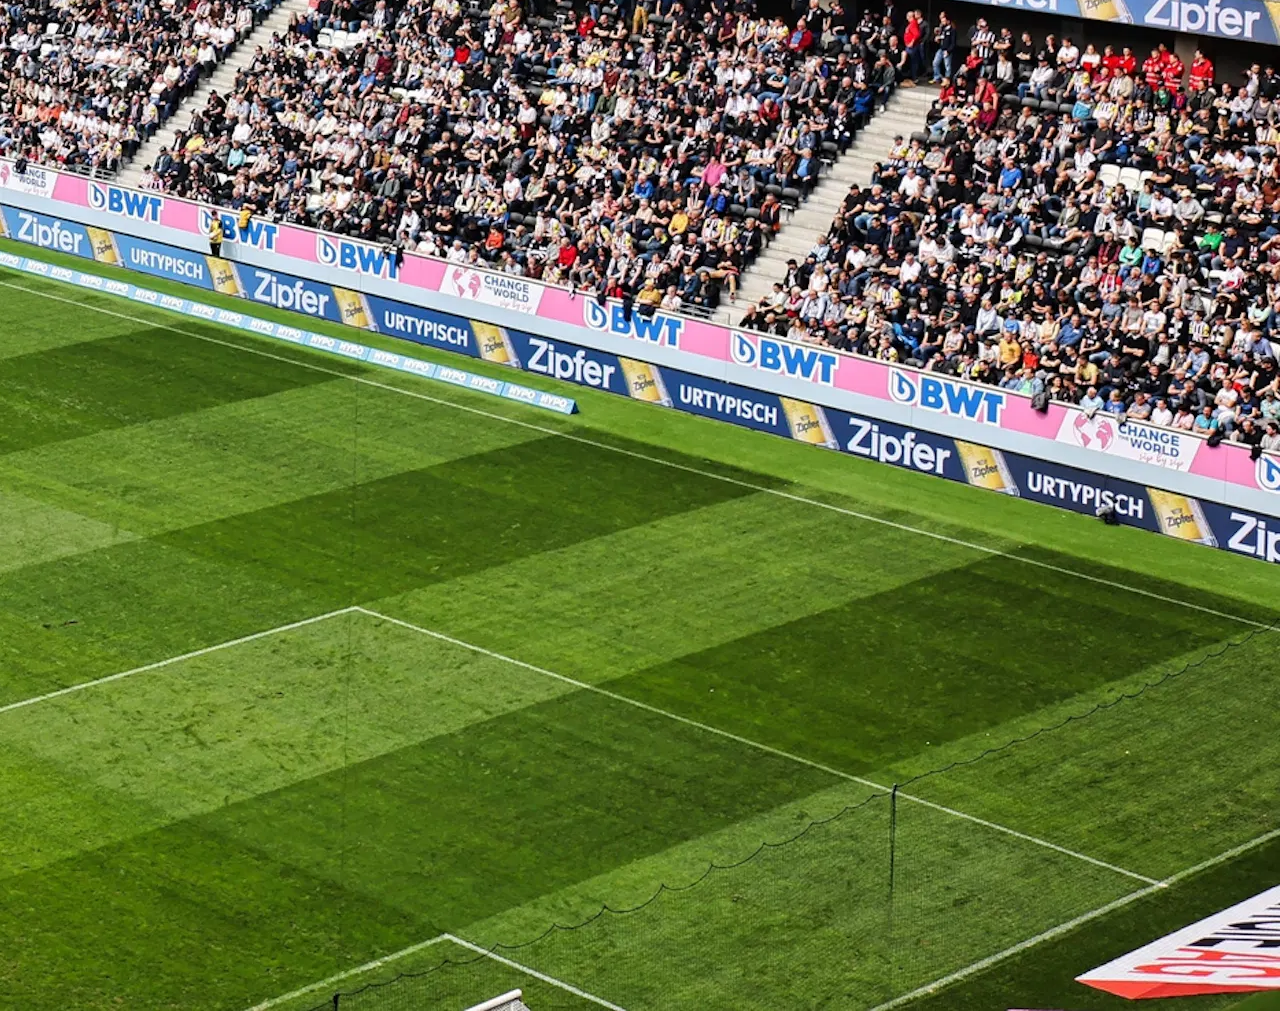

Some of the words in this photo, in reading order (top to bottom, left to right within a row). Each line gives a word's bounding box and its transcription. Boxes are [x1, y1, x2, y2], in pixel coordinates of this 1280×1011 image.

[109, 186, 162, 223] BWT
[18, 212, 83, 254] Zipfer
[222, 214, 277, 251] BWT
[131, 247, 203, 281] URTYPISCH
[254, 271, 329, 317] Zipfer
[484, 275, 529, 294] CHANGE
[493, 287, 529, 303] WORLD
[385, 310, 468, 348] URTYPISCH
[611, 303, 682, 348] BWT
[310, 334, 335, 347] HYPO
[340, 343, 364, 355] HYPO
[374, 352, 398, 365] HYPO
[404, 359, 429, 372] HYPO
[528, 338, 615, 389] Zipfer
[760, 340, 837, 385] BWT
[440, 369, 466, 382] HYPO
[471, 377, 497, 390] HYPO
[509, 386, 535, 399] HYPO
[540, 394, 568, 408] HYPO
[921, 377, 1005, 425] BWT
[680, 384, 778, 427] URTYPISCH
[847, 417, 951, 475] Zipfer
[1118, 423, 1180, 447] CHANGE
[1130, 437, 1179, 458] WORLD
[972, 462, 998, 480] Zipfer
[1027, 471, 1143, 520] URTYPISCH
[1166, 511, 1193, 529] Zipfer
